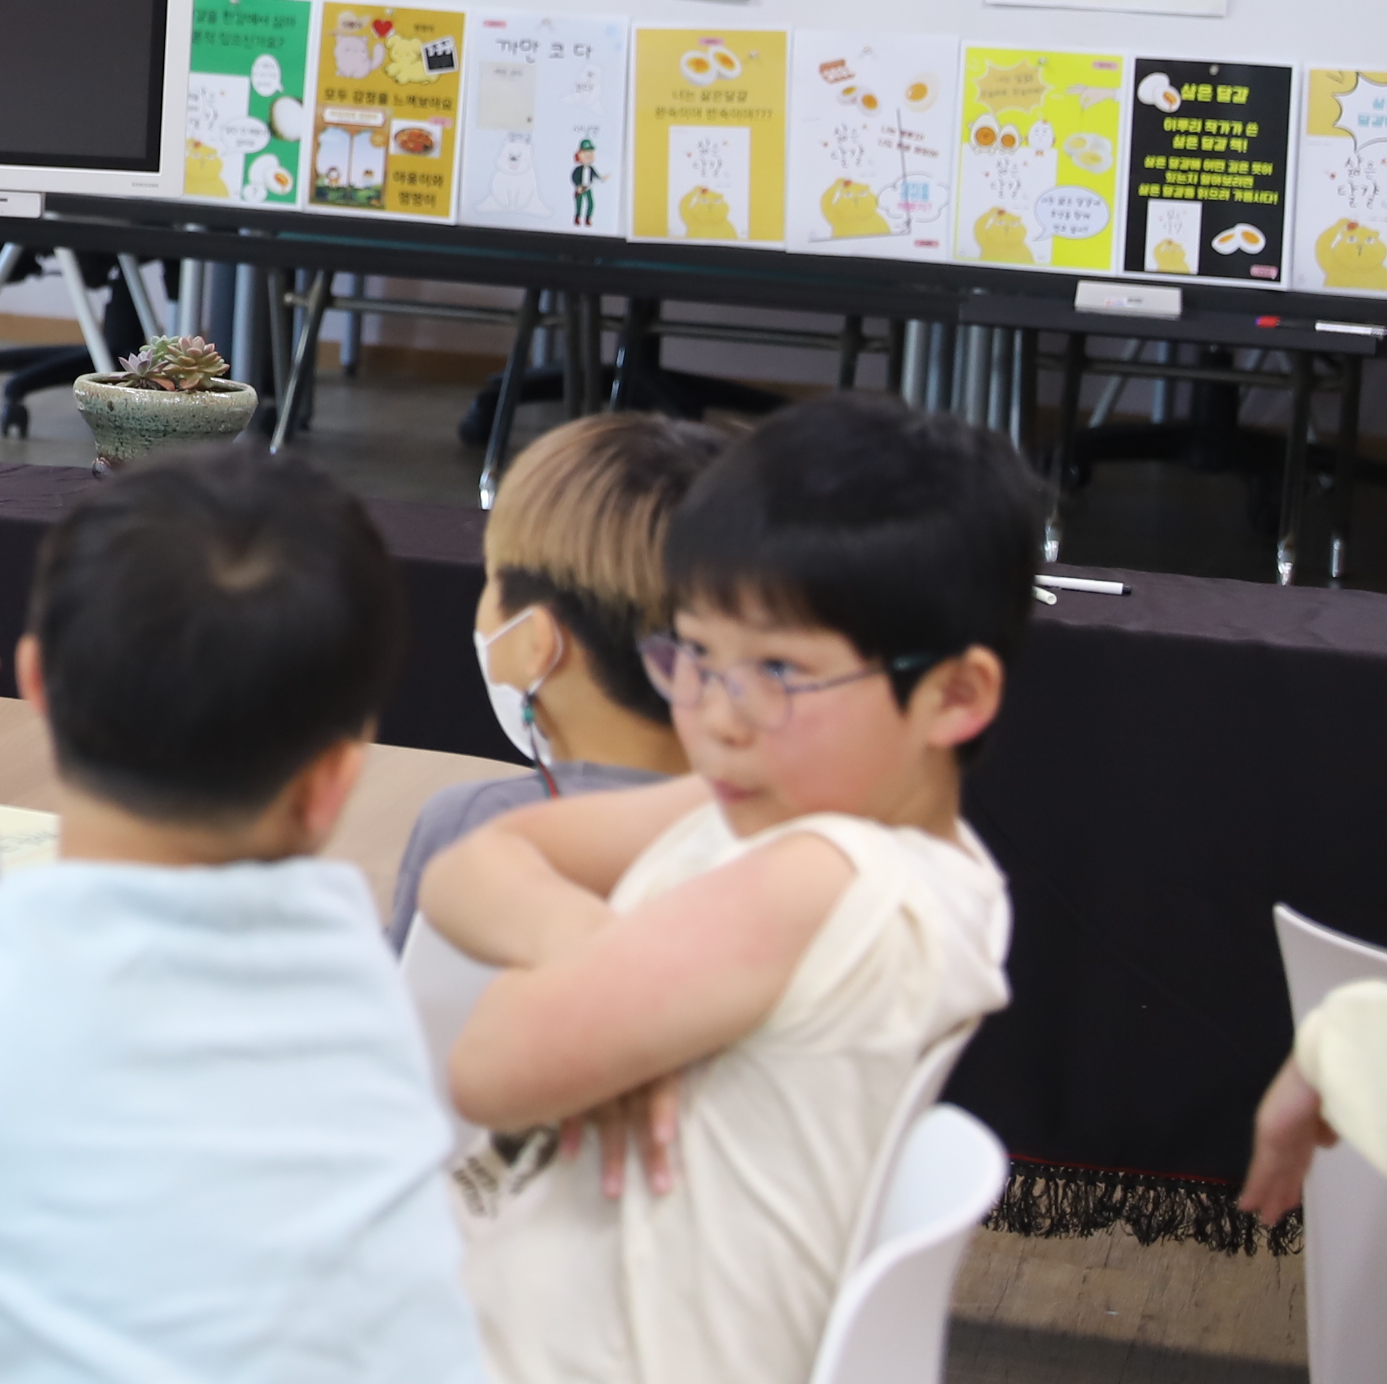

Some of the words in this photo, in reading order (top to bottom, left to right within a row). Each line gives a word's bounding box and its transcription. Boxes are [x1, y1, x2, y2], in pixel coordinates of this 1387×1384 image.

[1181, 83, 1213, 102] 삶은
[1216, 85, 1250, 104] 달걀
[1163, 116, 1202, 133] 이루리
[1204, 119, 1243, 136] 작가가
[1172, 134, 1199, 150] 삶은
[1201, 136, 1227, 152] 달걀
[1144, 155, 1167, 169] 삶은
[1138, 183, 1161, 197] 삶은
